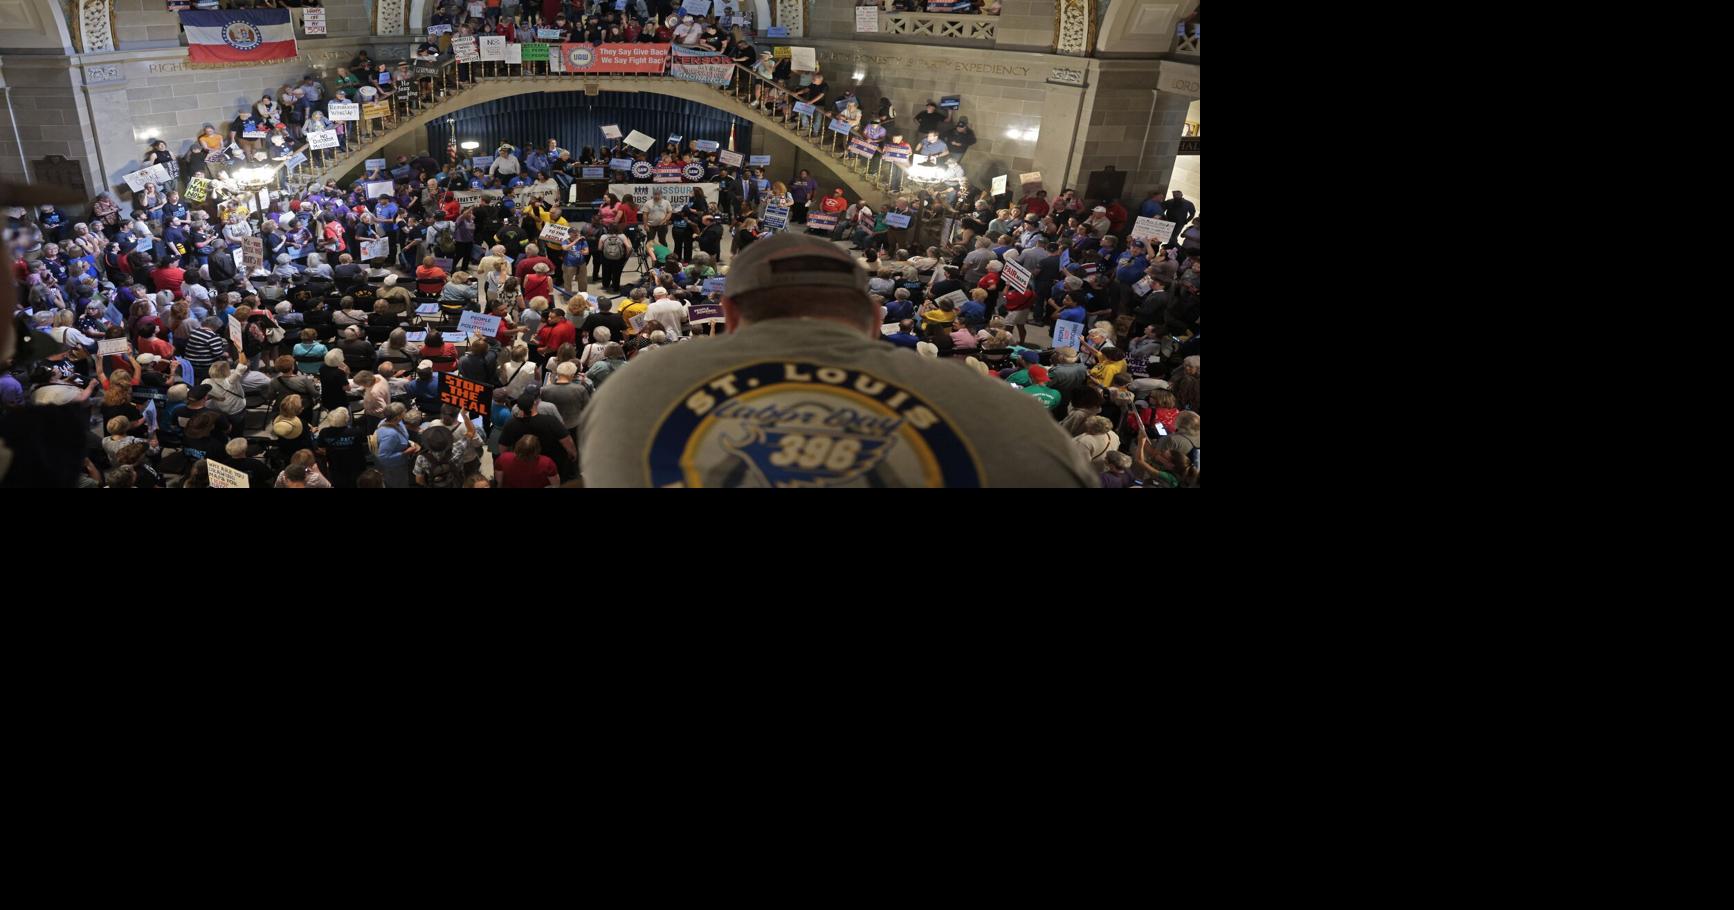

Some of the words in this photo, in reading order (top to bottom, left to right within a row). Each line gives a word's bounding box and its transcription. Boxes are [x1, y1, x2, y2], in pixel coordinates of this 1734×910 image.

[600, 48, 618, 58] They
[620, 48, 632, 58] Say
[652, 49, 668, 57] Back
[614, 58, 627, 66] Say
[629, 57, 647, 66] Fight
[955, 61, 1031, 77] EXPEDIENCY
[652, 186, 692, 194] MISSOUR
[630, 196, 648, 204] OBS
[1004, 265, 1018, 278] FAIR
[1015, 274, 1027, 286] MAPS
[461, 323, 497, 334] POLITICIANS
[445, 375, 484, 393] STOP
[450, 385, 479, 402] THE
[686, 374, 760, 416] ST.
[782, 363, 940, 430] LOUIS
[441, 392, 487, 416] STEAL
[710, 401, 814, 424] Labor
[822, 408, 904, 434] Day
[770, 434, 862, 471] 396
